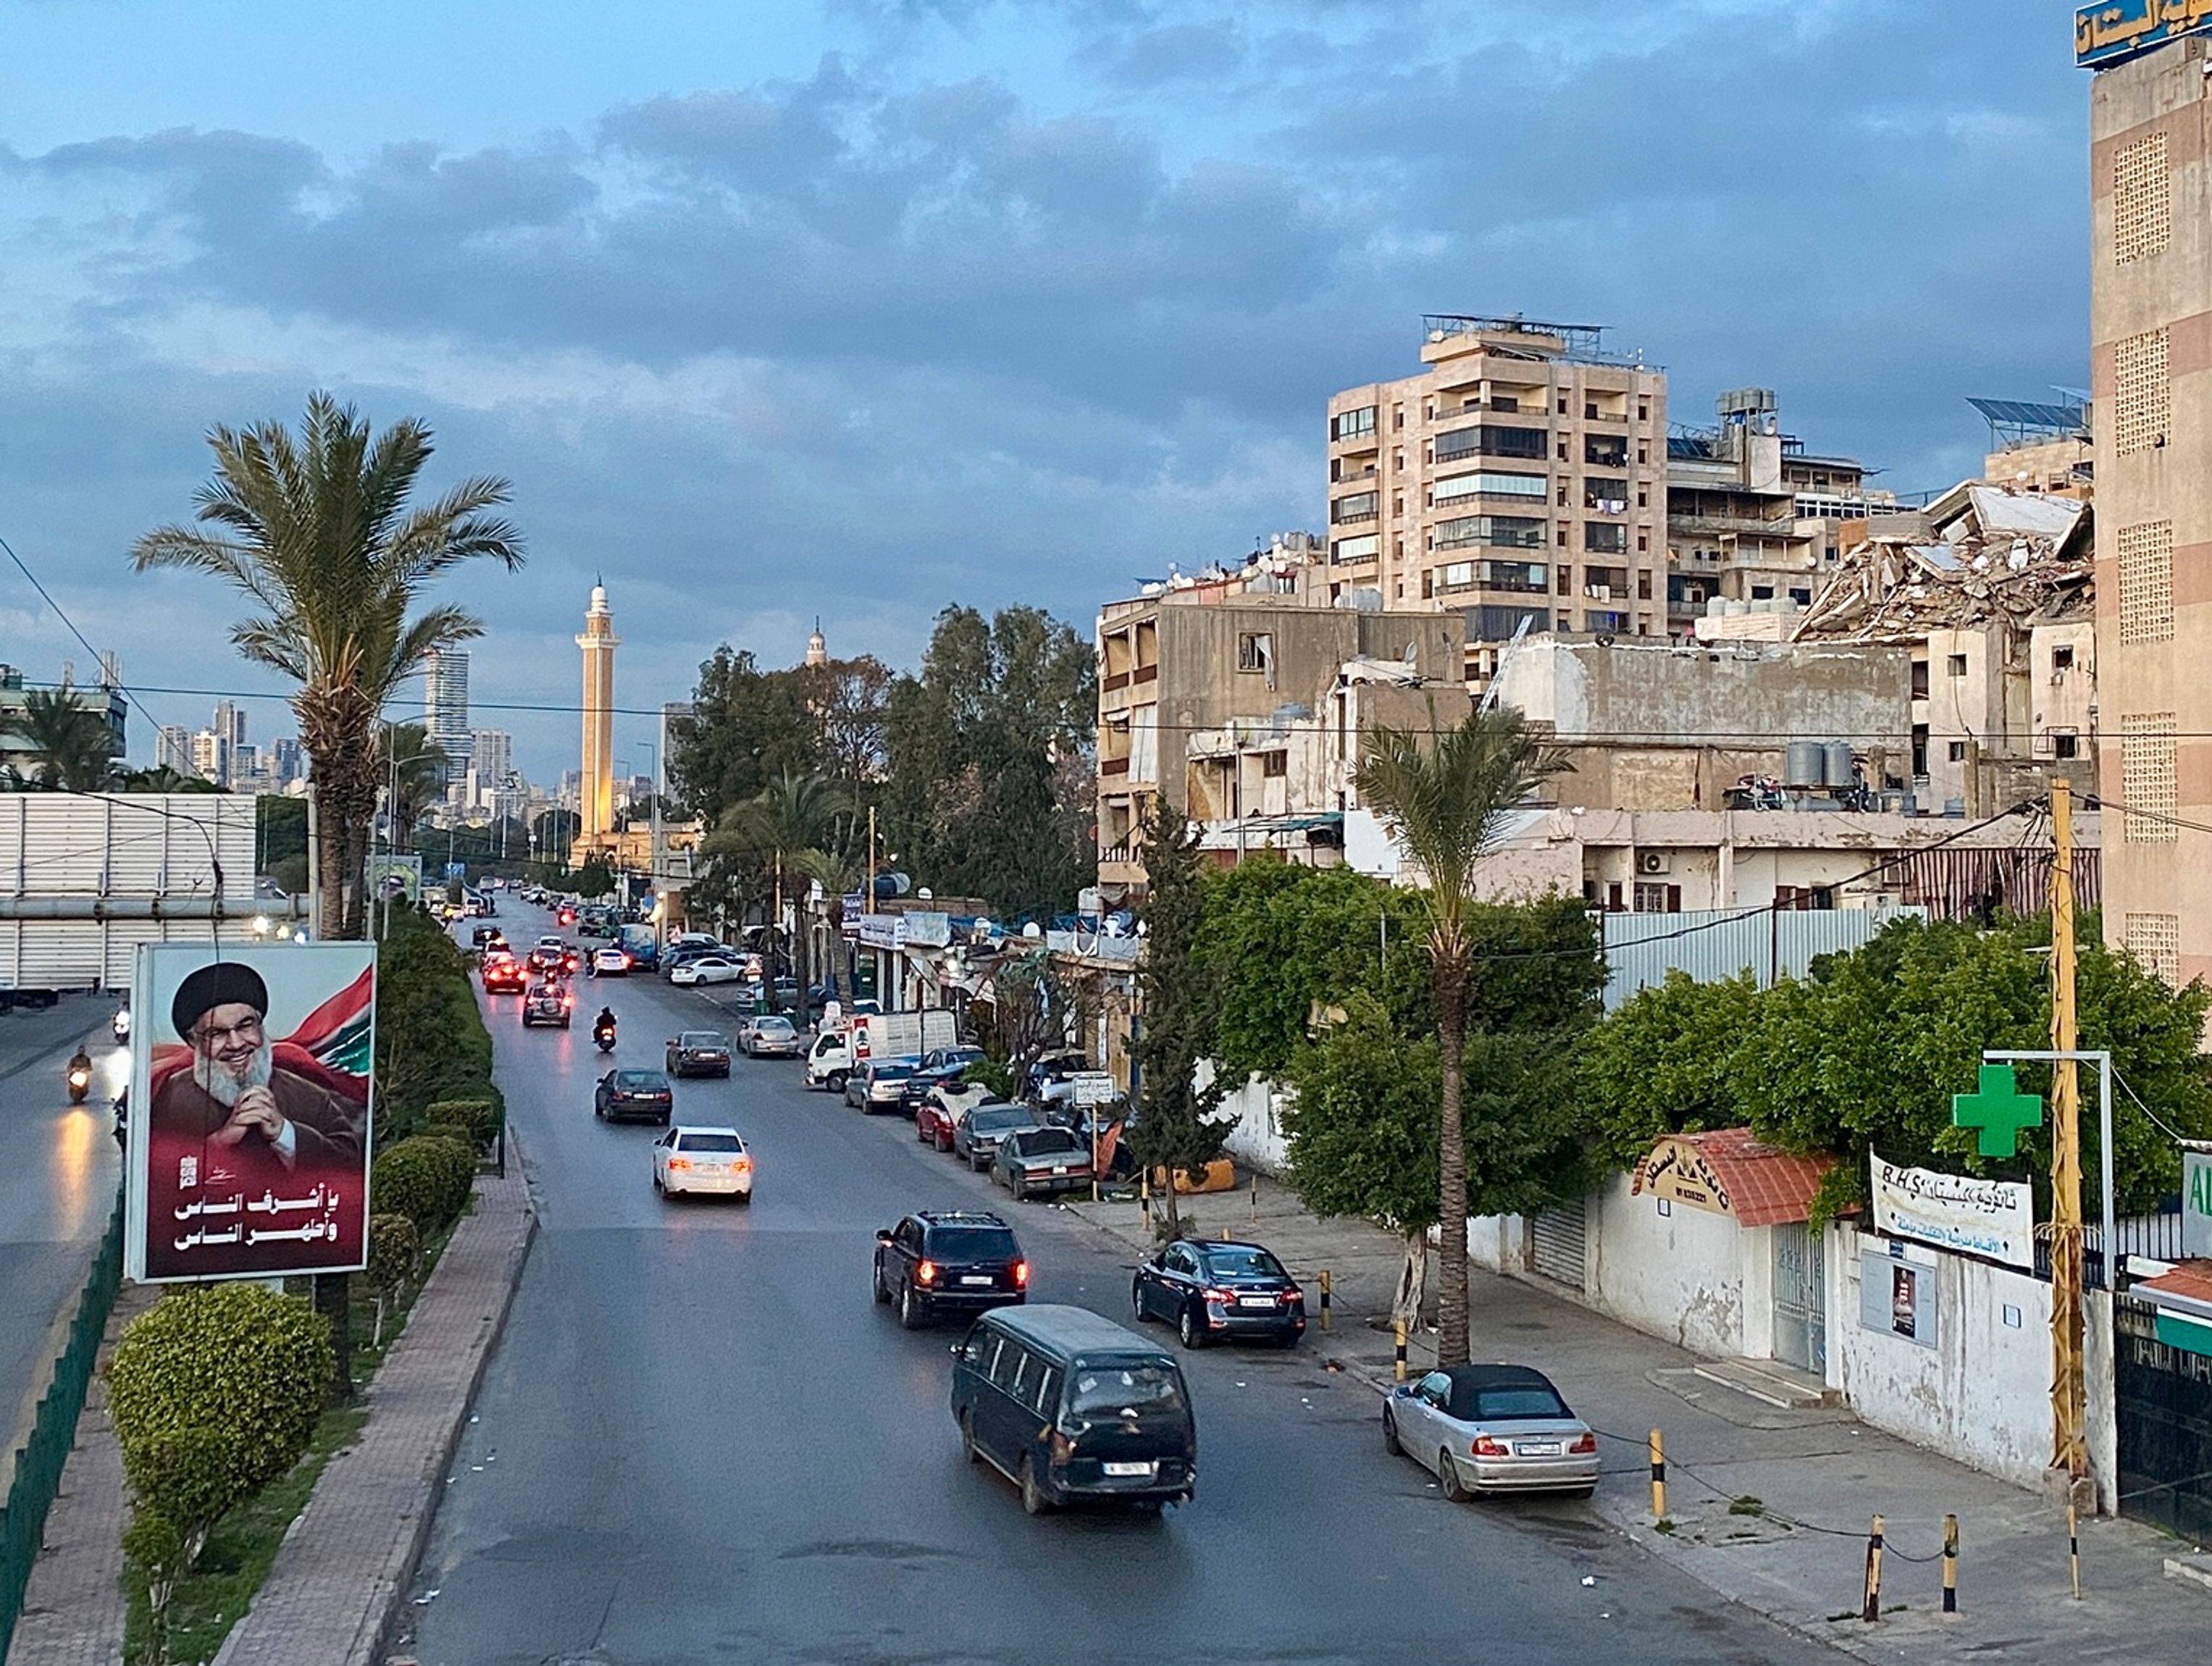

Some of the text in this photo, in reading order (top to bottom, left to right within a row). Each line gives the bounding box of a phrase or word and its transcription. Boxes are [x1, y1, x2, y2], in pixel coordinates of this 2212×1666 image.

[174, 1182, 339, 1221] يا أشرف الناس
[173, 1222, 243, 1251] الناس
